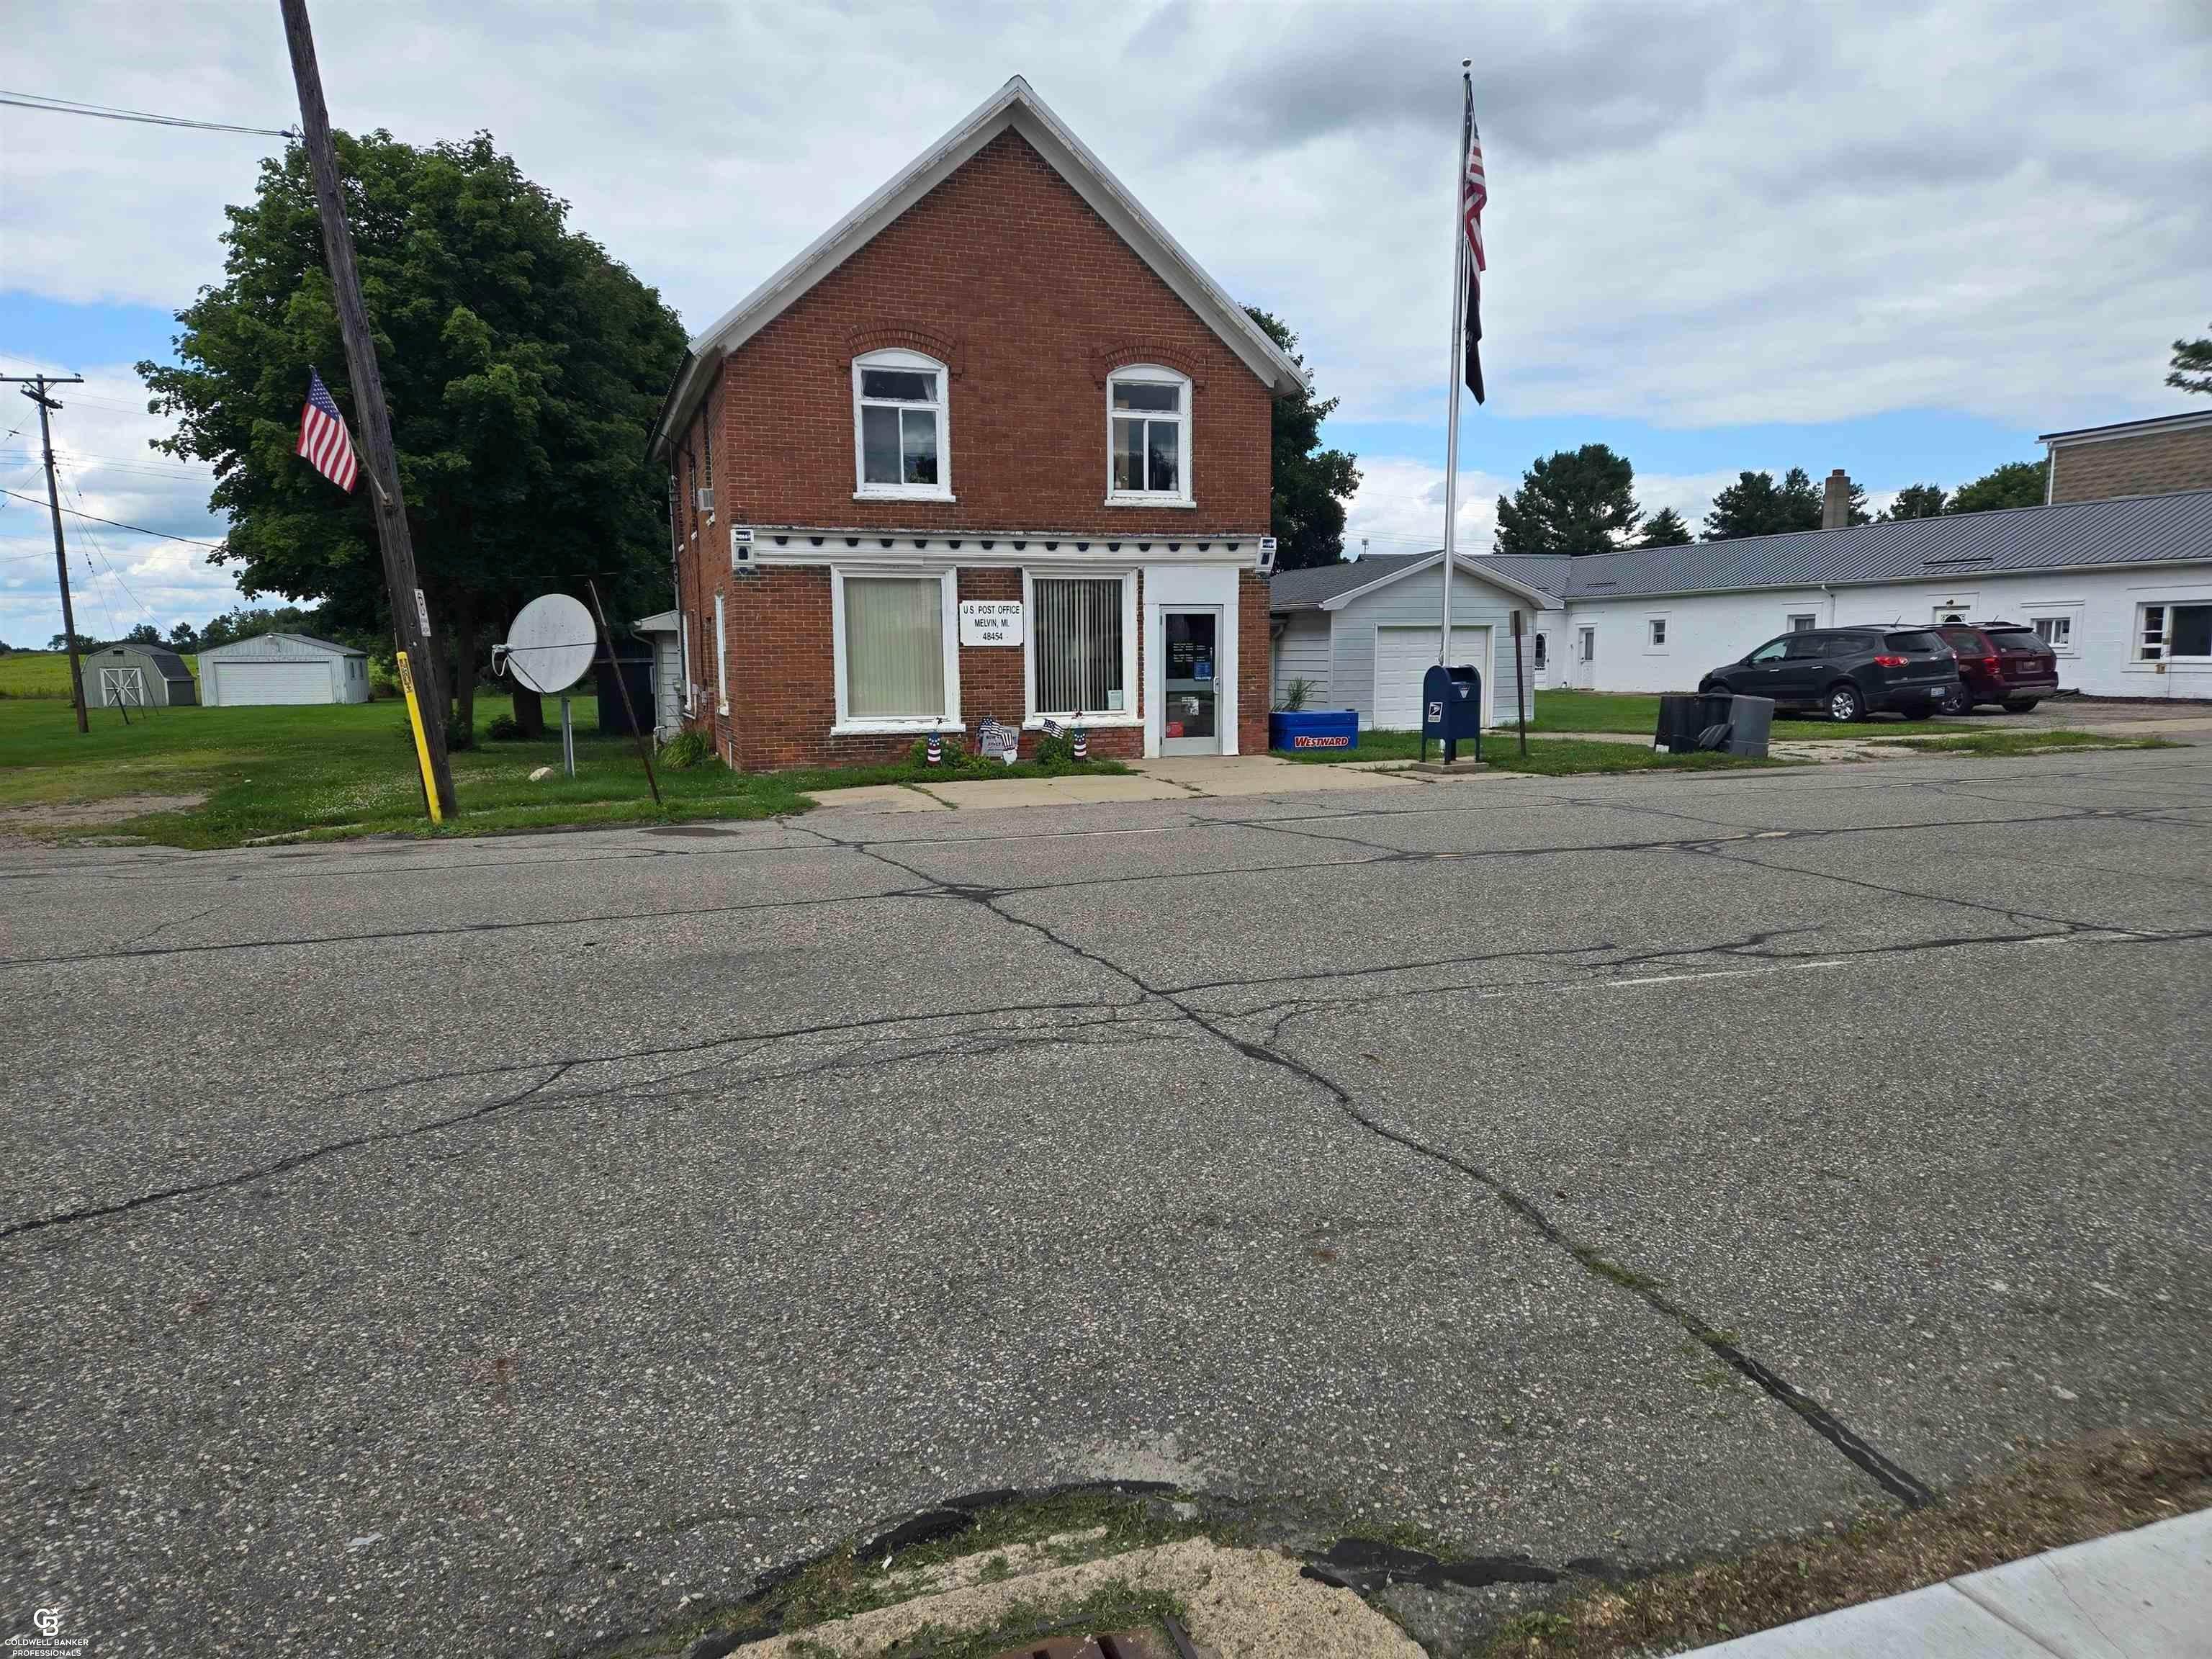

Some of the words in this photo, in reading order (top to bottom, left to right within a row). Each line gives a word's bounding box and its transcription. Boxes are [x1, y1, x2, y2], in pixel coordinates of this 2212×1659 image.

[978, 605, 995, 614] POST
[998, 605, 1020, 614] OFFICE
[982, 632, 1003, 641] 48454
[1295, 737, 1349, 747] WESTWARD
